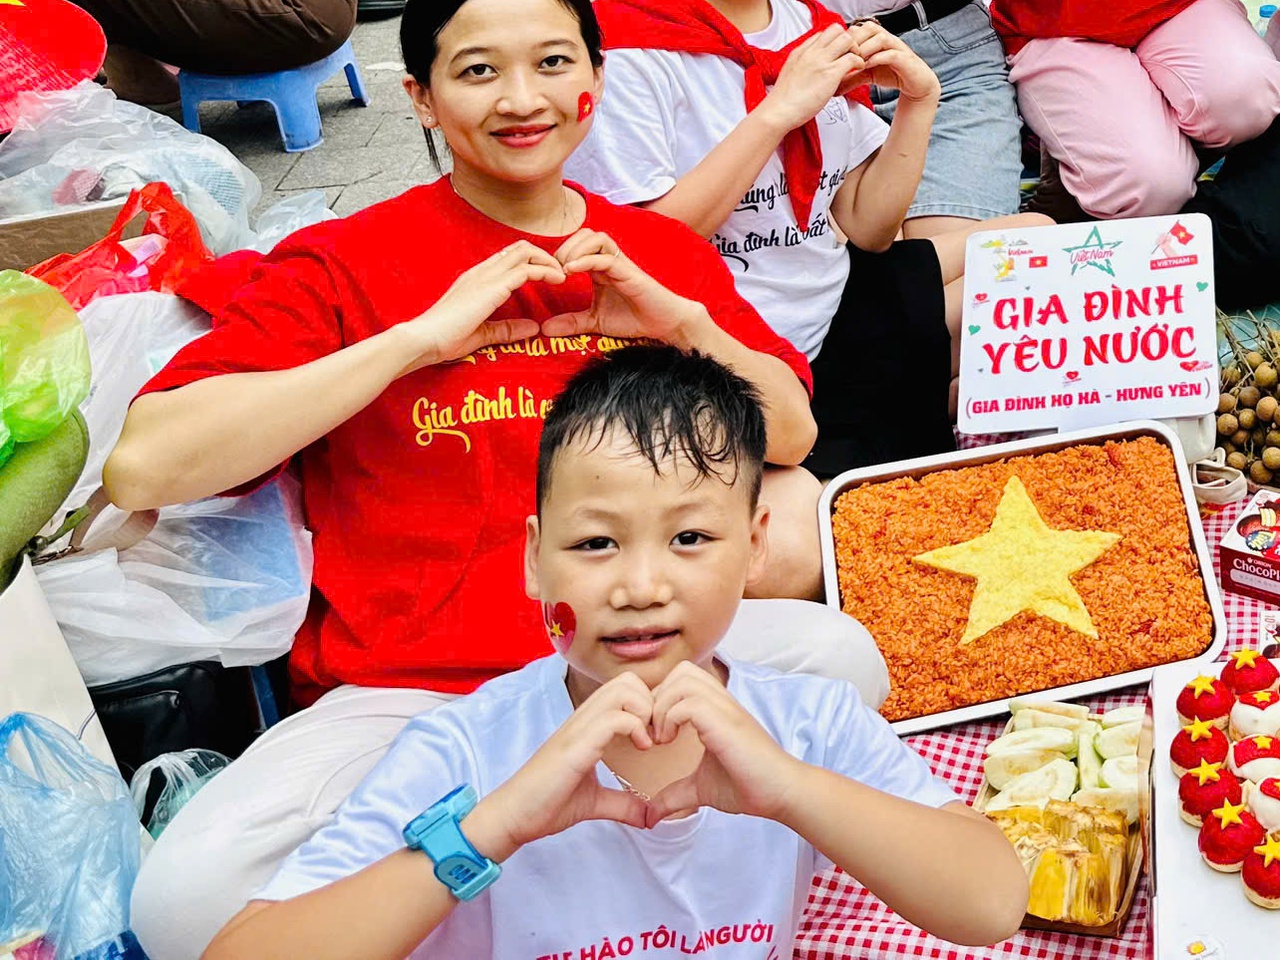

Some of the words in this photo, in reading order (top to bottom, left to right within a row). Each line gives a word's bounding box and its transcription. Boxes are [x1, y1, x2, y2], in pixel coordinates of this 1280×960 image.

[744, 228, 782, 253] đình
[784, 225, 803, 247] là
[1090, 248, 1115, 261] Nam
[1156, 257, 1192, 269] VIETNAM
[993, 293, 1070, 332] GIA
[1083, 284, 1184, 323] ĐÌNH
[982, 334, 1068, 375] YÊU
[1083, 323, 1198, 367] NƯỚC
[1004, 395, 1046, 412] ĐÌNH
[1050, 393, 1074, 409] HỌ
[1077, 389, 1102, 406] HÀ
[1116, 384, 1164, 403] HƯNG
[412, 396, 472, 454] Gia
[459, 385, 517, 425] đình
[517, 386, 538, 419] là
[580, 936, 634, 960] HÀO
[640, 923, 678, 951] TÔI
[704, 918, 775, 948] NGƯỜI
